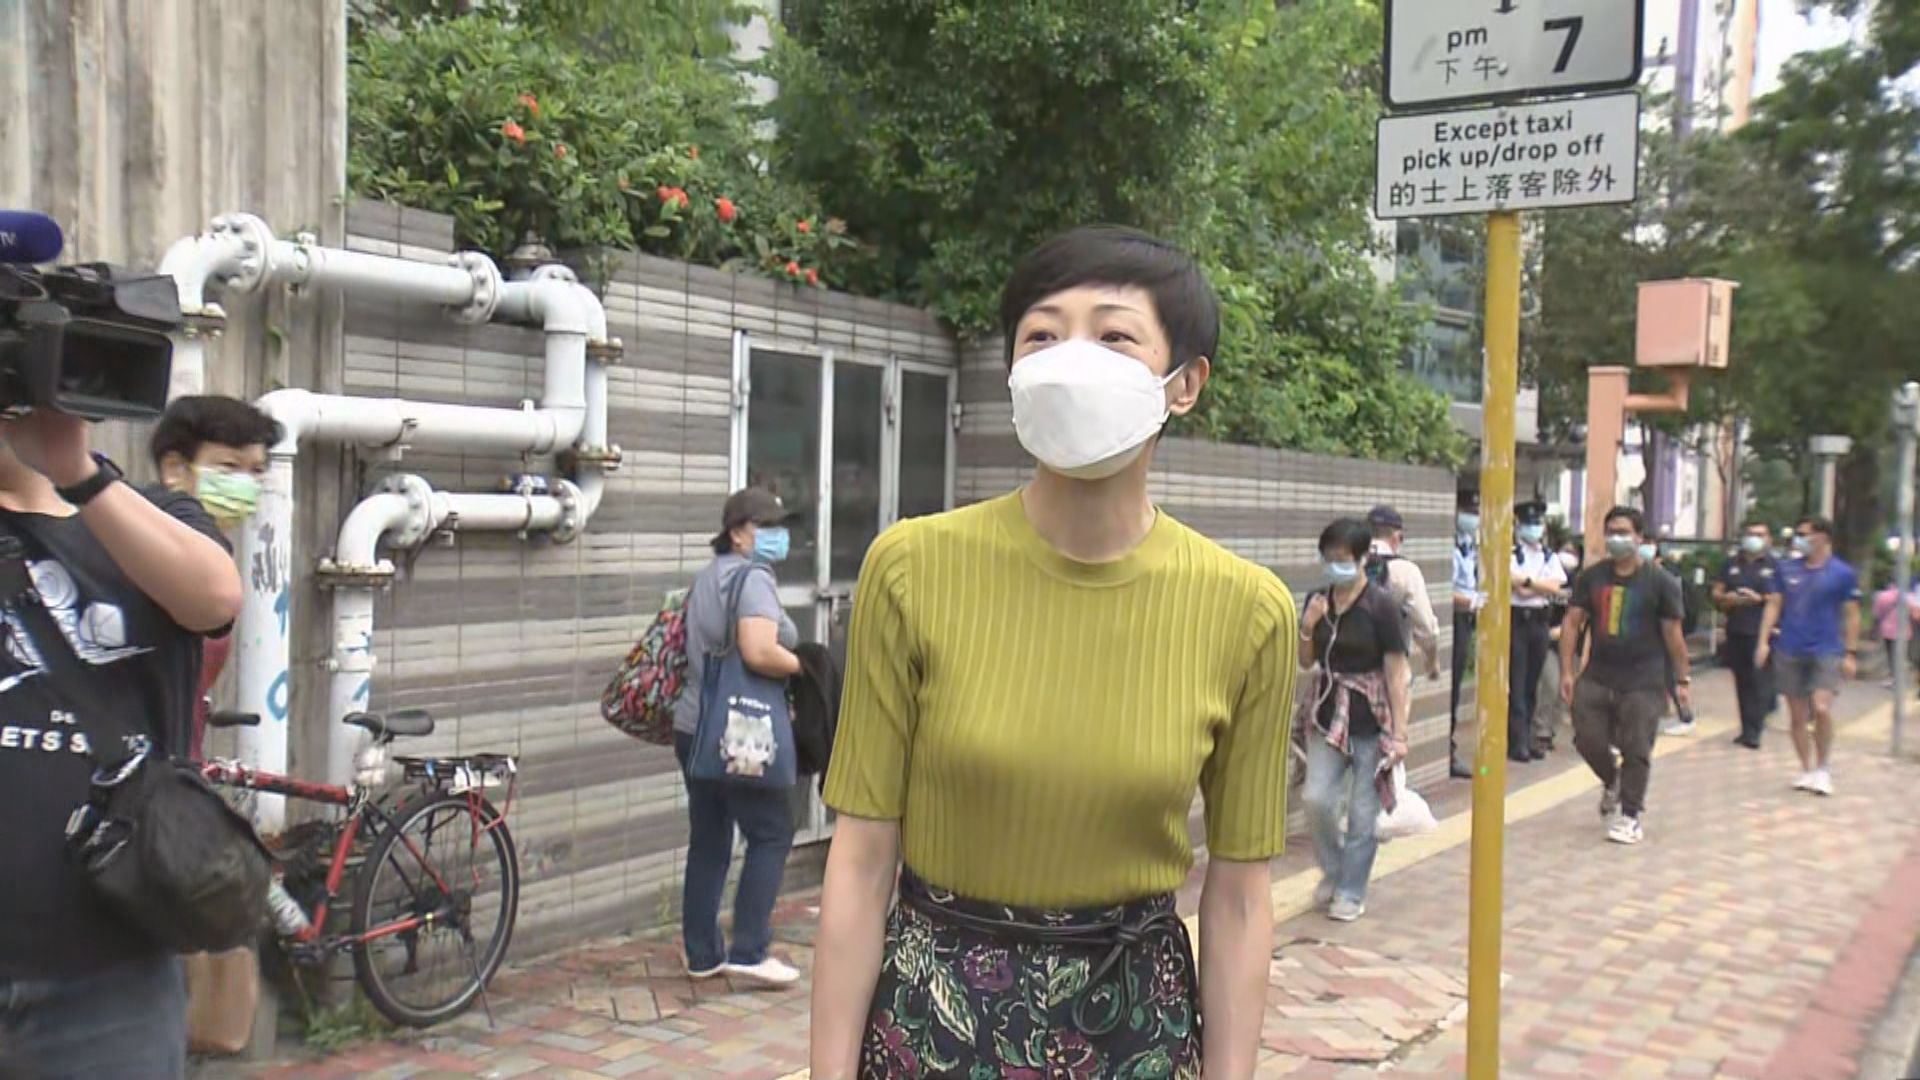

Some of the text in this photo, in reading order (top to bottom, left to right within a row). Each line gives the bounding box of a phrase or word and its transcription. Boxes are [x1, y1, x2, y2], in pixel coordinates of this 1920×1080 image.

[1447, 28, 1487, 52] pm
[1543, 16, 1583, 73] 7
[1436, 55, 1498, 84] 下午
[1434, 110, 1573, 143] Except taxi
[1403, 133, 1605, 174] pick up/drop off
[1390, 164, 1617, 207] 的士上落客除外
